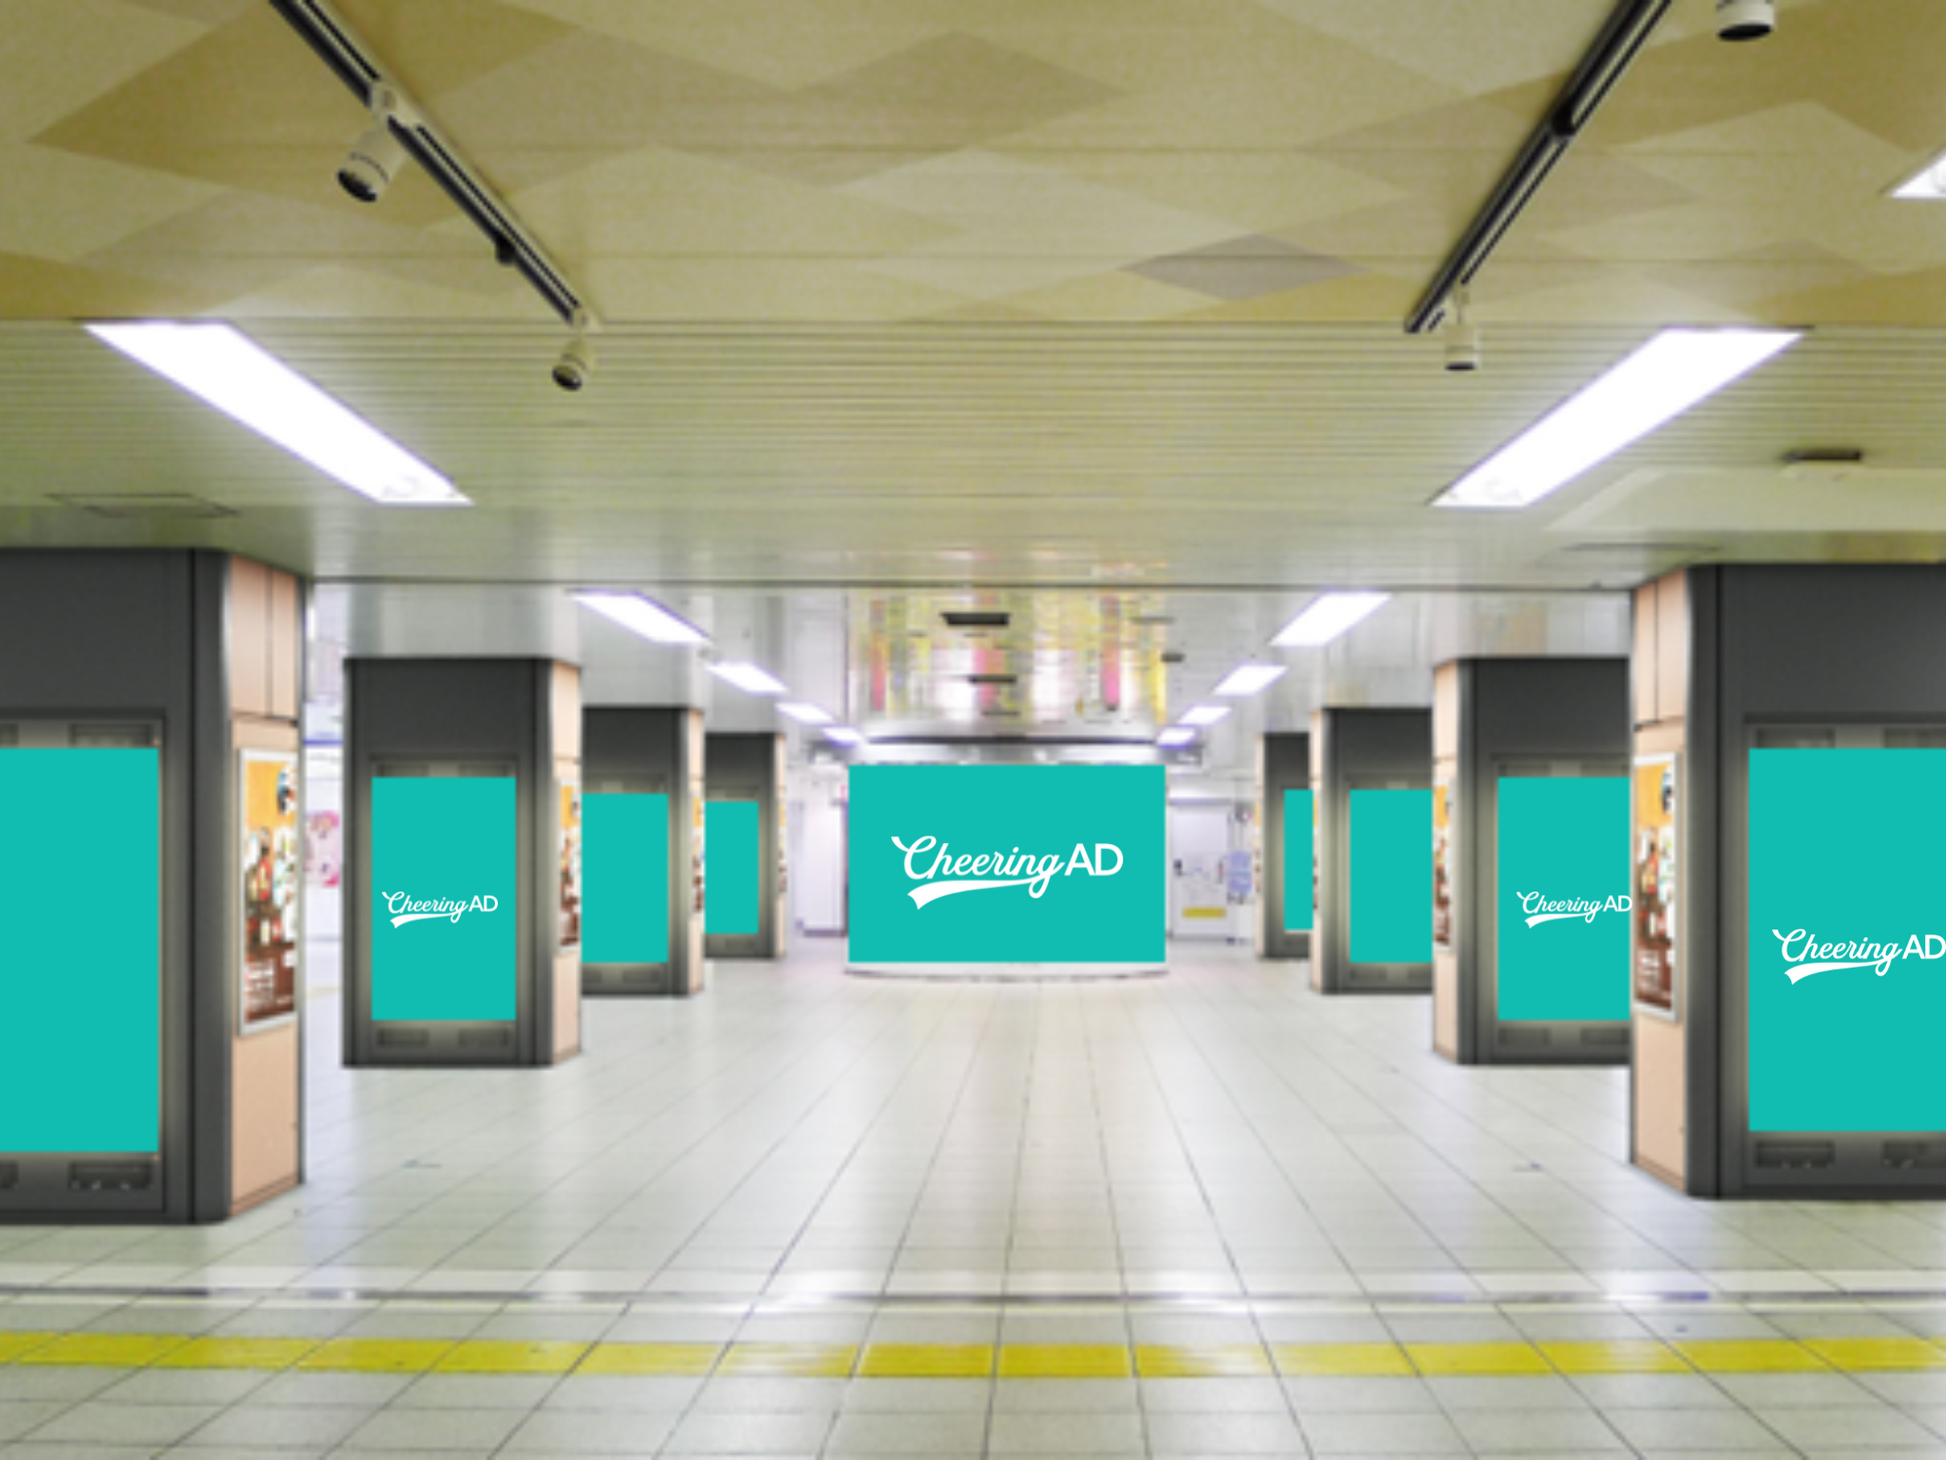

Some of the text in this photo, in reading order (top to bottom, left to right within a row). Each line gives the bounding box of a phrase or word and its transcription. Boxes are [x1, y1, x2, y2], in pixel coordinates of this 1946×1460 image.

[891, 836, 1124, 909] Cheering AD
[381, 891, 499, 928] Cheering AD
[1516, 891, 1632, 928] Cheering AD
[1772, 929, 1946, 985] Cheering AD
